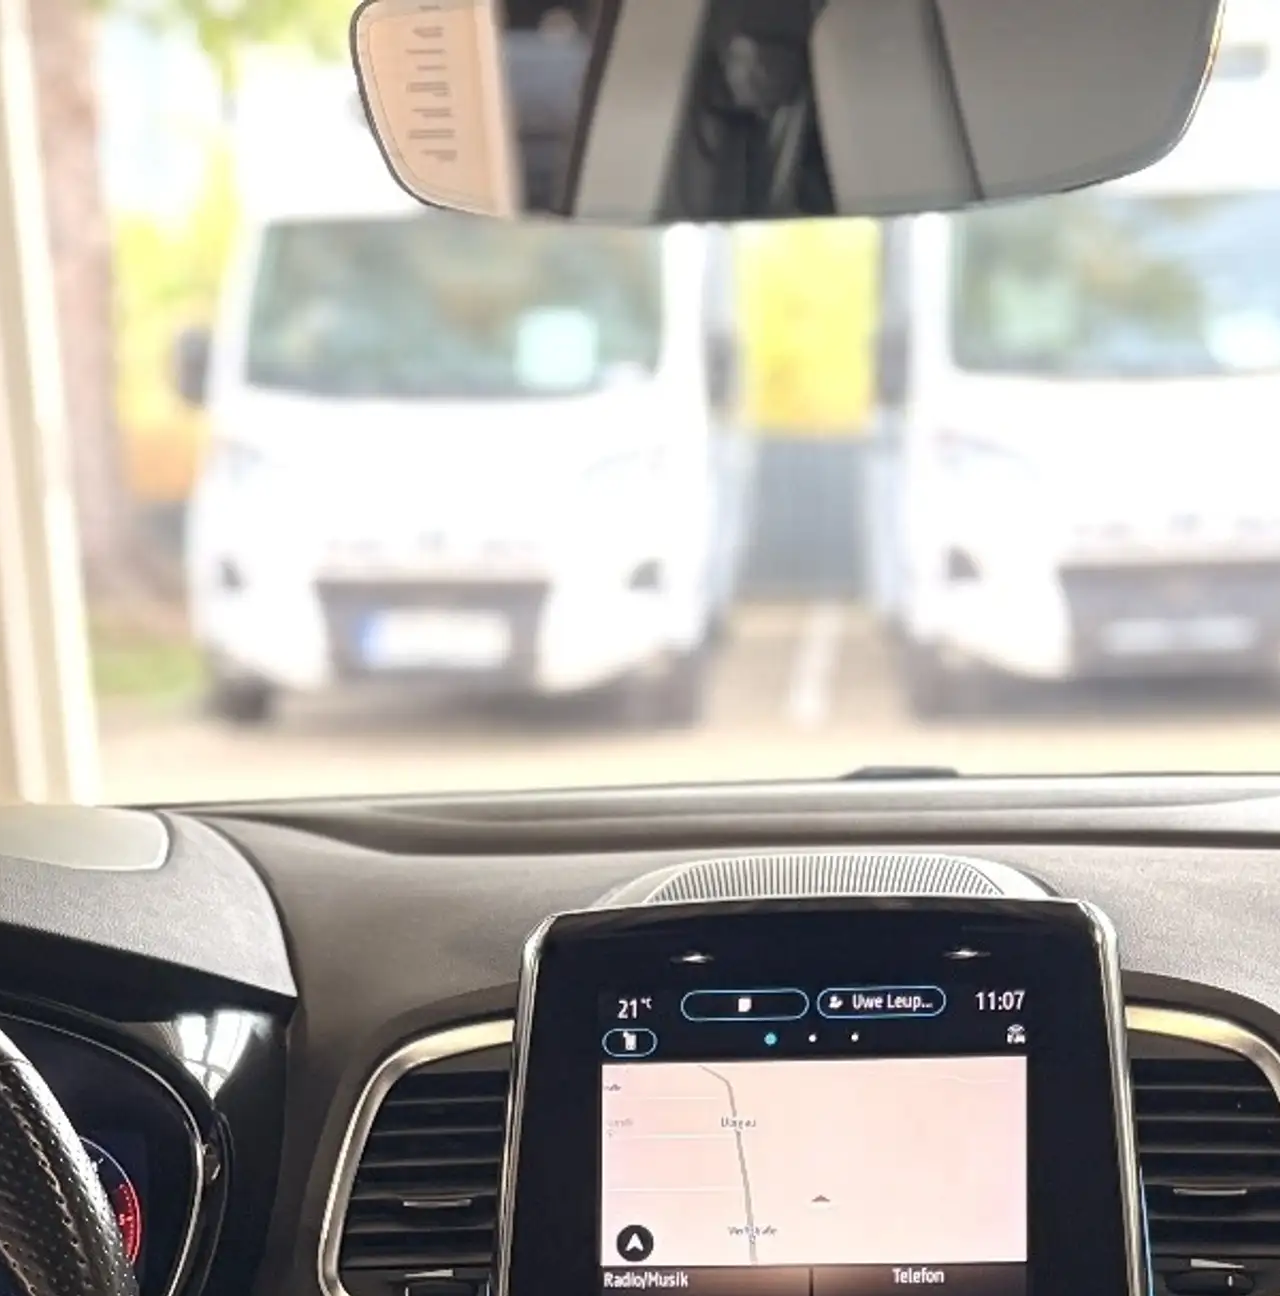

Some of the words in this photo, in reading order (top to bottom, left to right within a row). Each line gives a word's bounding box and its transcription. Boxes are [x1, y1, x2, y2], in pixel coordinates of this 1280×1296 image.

[851, 993, 883, 1009] Uwe
[975, 990, 1025, 1011] 11:07
[603, 1271, 689, 1289] Radio/Musik
[892, 1267, 945, 1284] Telefon
